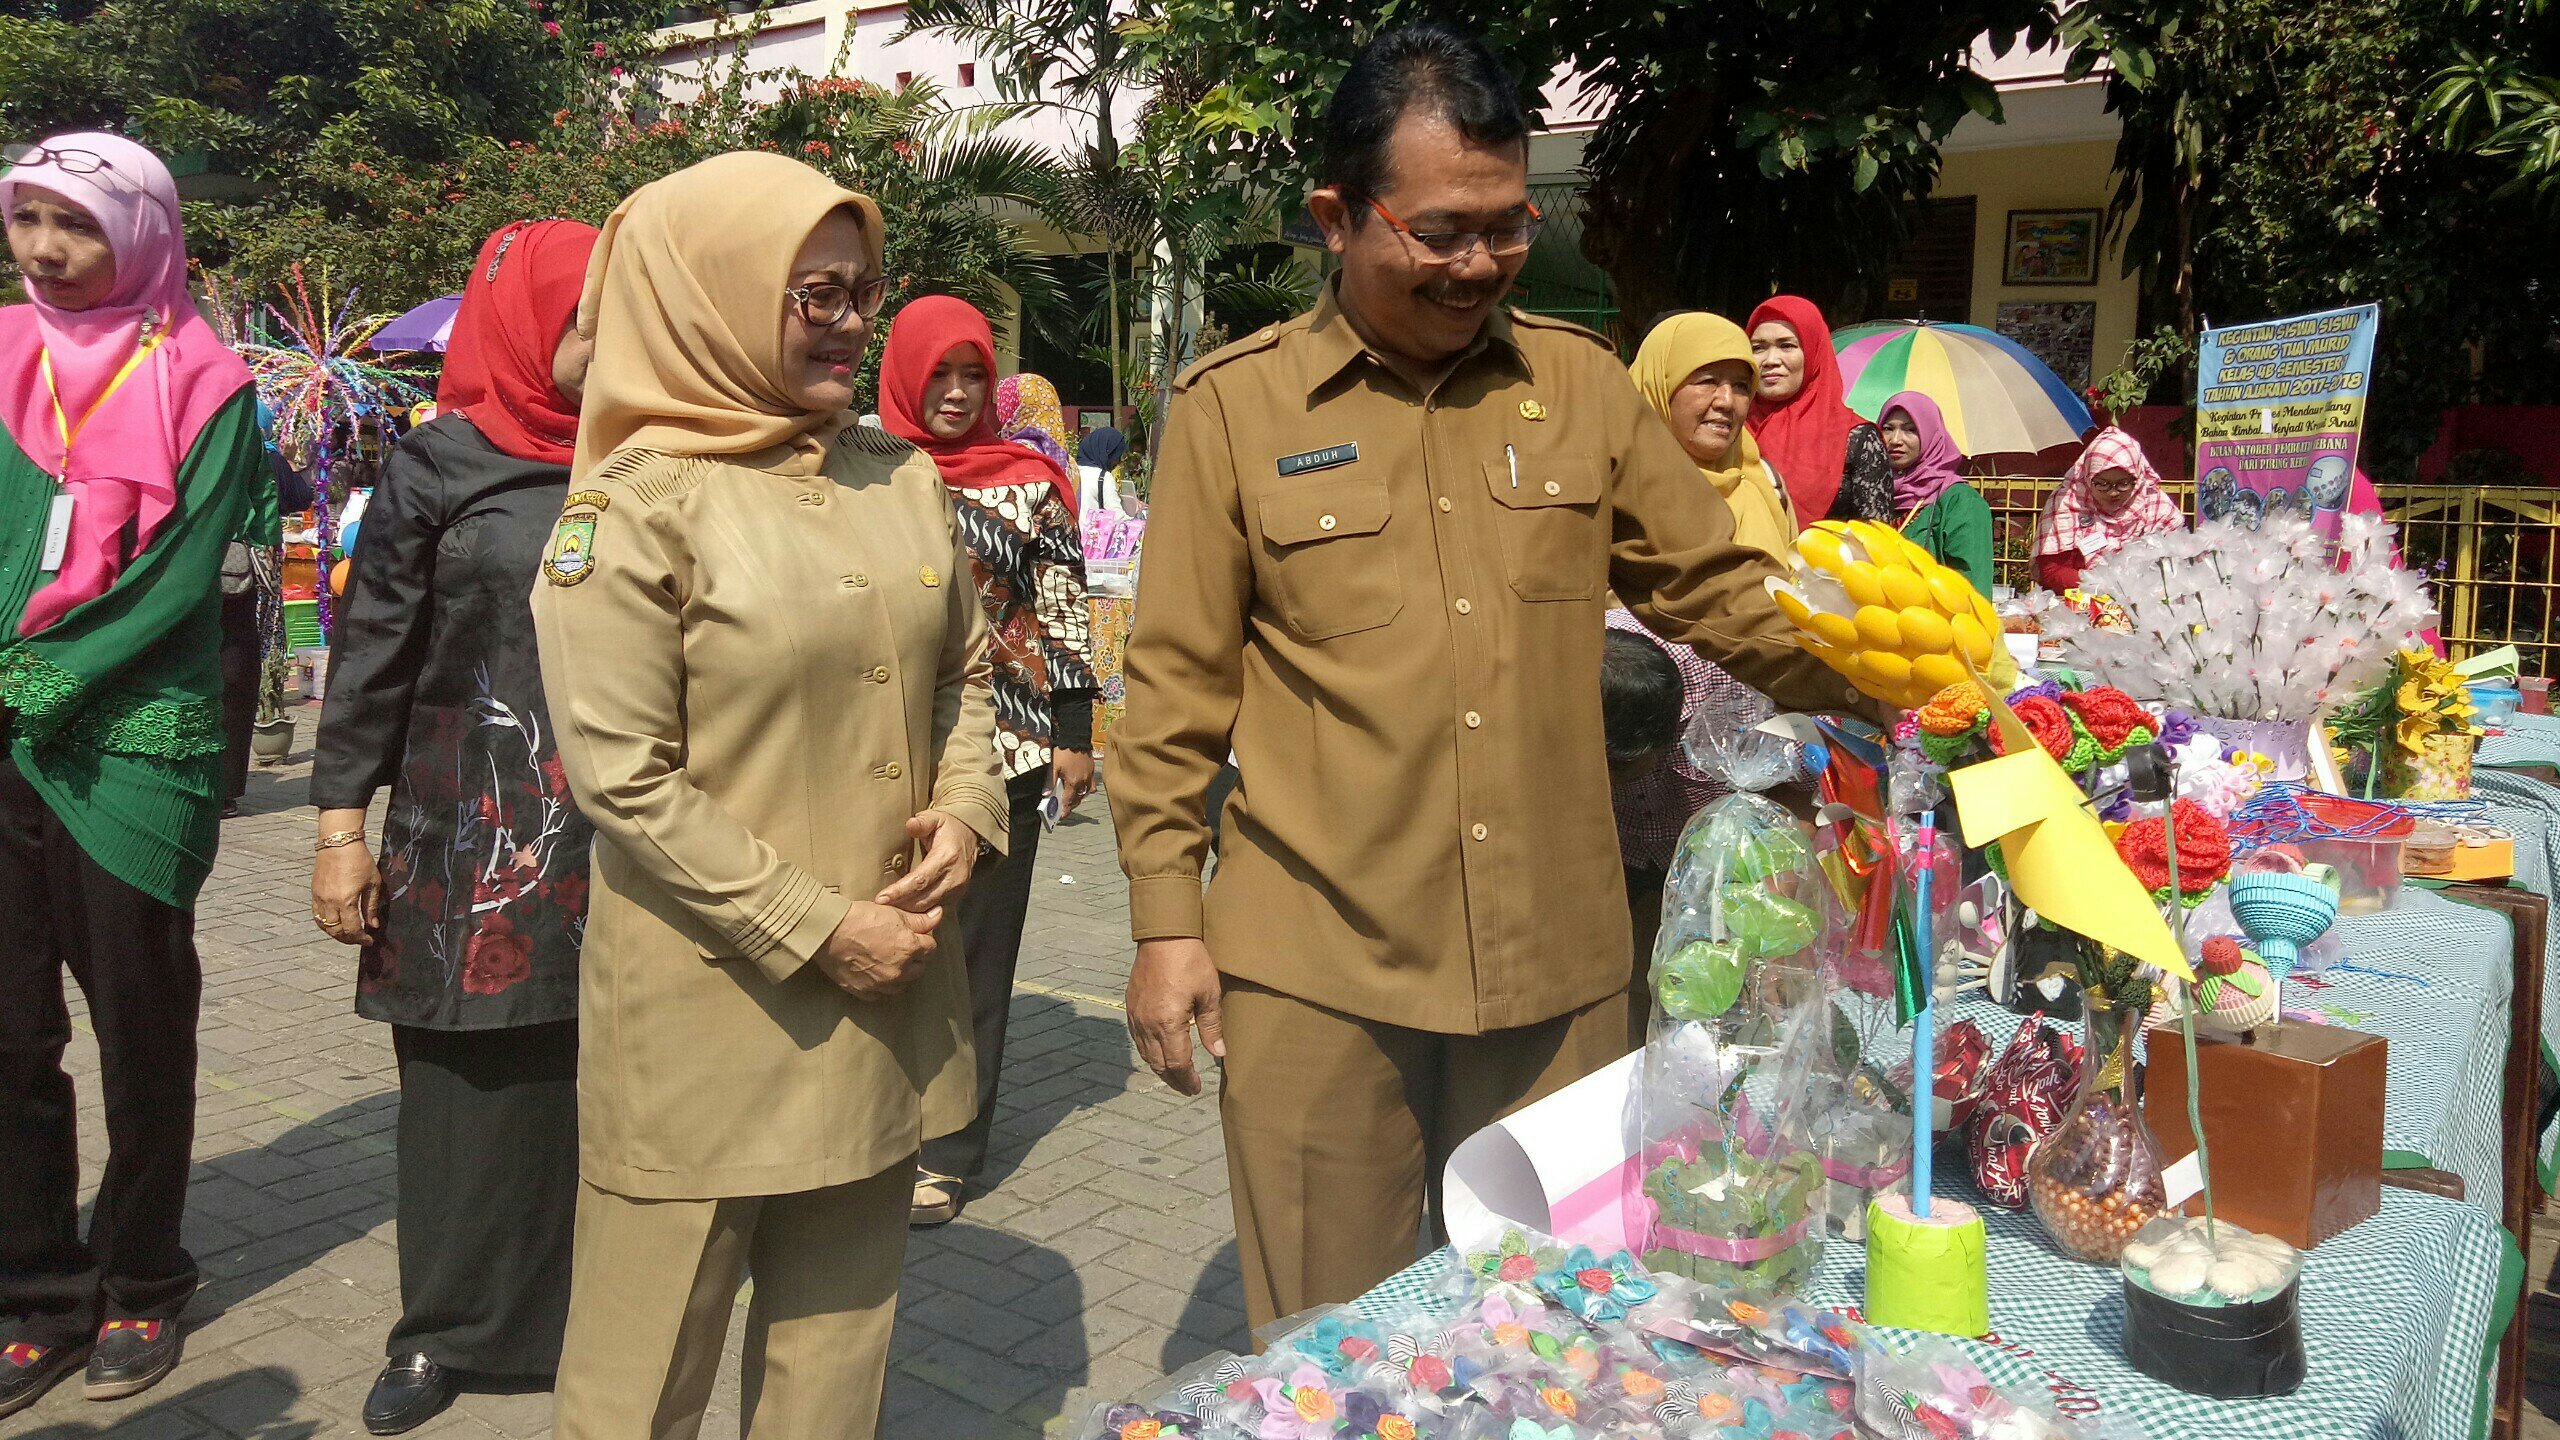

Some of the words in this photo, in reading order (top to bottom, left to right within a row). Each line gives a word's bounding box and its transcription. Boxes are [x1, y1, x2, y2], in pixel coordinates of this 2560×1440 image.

[2216, 325, 2275, 347] KEGIATAN
[2276, 319, 2317, 339] SISWA
[2318, 313, 2359, 334] SISWI
[2223, 348, 2236, 365] &
[2236, 343, 2280, 364] ORANG
[2281, 340, 2305, 358] TUA
[2305, 334, 2351, 355] MURID
[2218, 365, 2256, 383] KELAS
[2256, 363, 2276, 379] 4B
[2276, 355, 2342, 378] SEMESTER
[2204, 385, 2243, 403] TAHUN
[2242, 380, 2291, 401] AJARAN
[2210, 411, 2247, 425] Kegiatan
[2249, 408, 2280, 420] Pres
[2282, 405, 2324, 418] Mendaur
[2200, 426, 2228, 437] Bahan
[2231, 424, 2263, 436] Limba
[1296, 450, 1338, 467] ABDUH
[2209, 445, 2233, 458] BULAN
[2238, 458, 2259, 471] DARI
